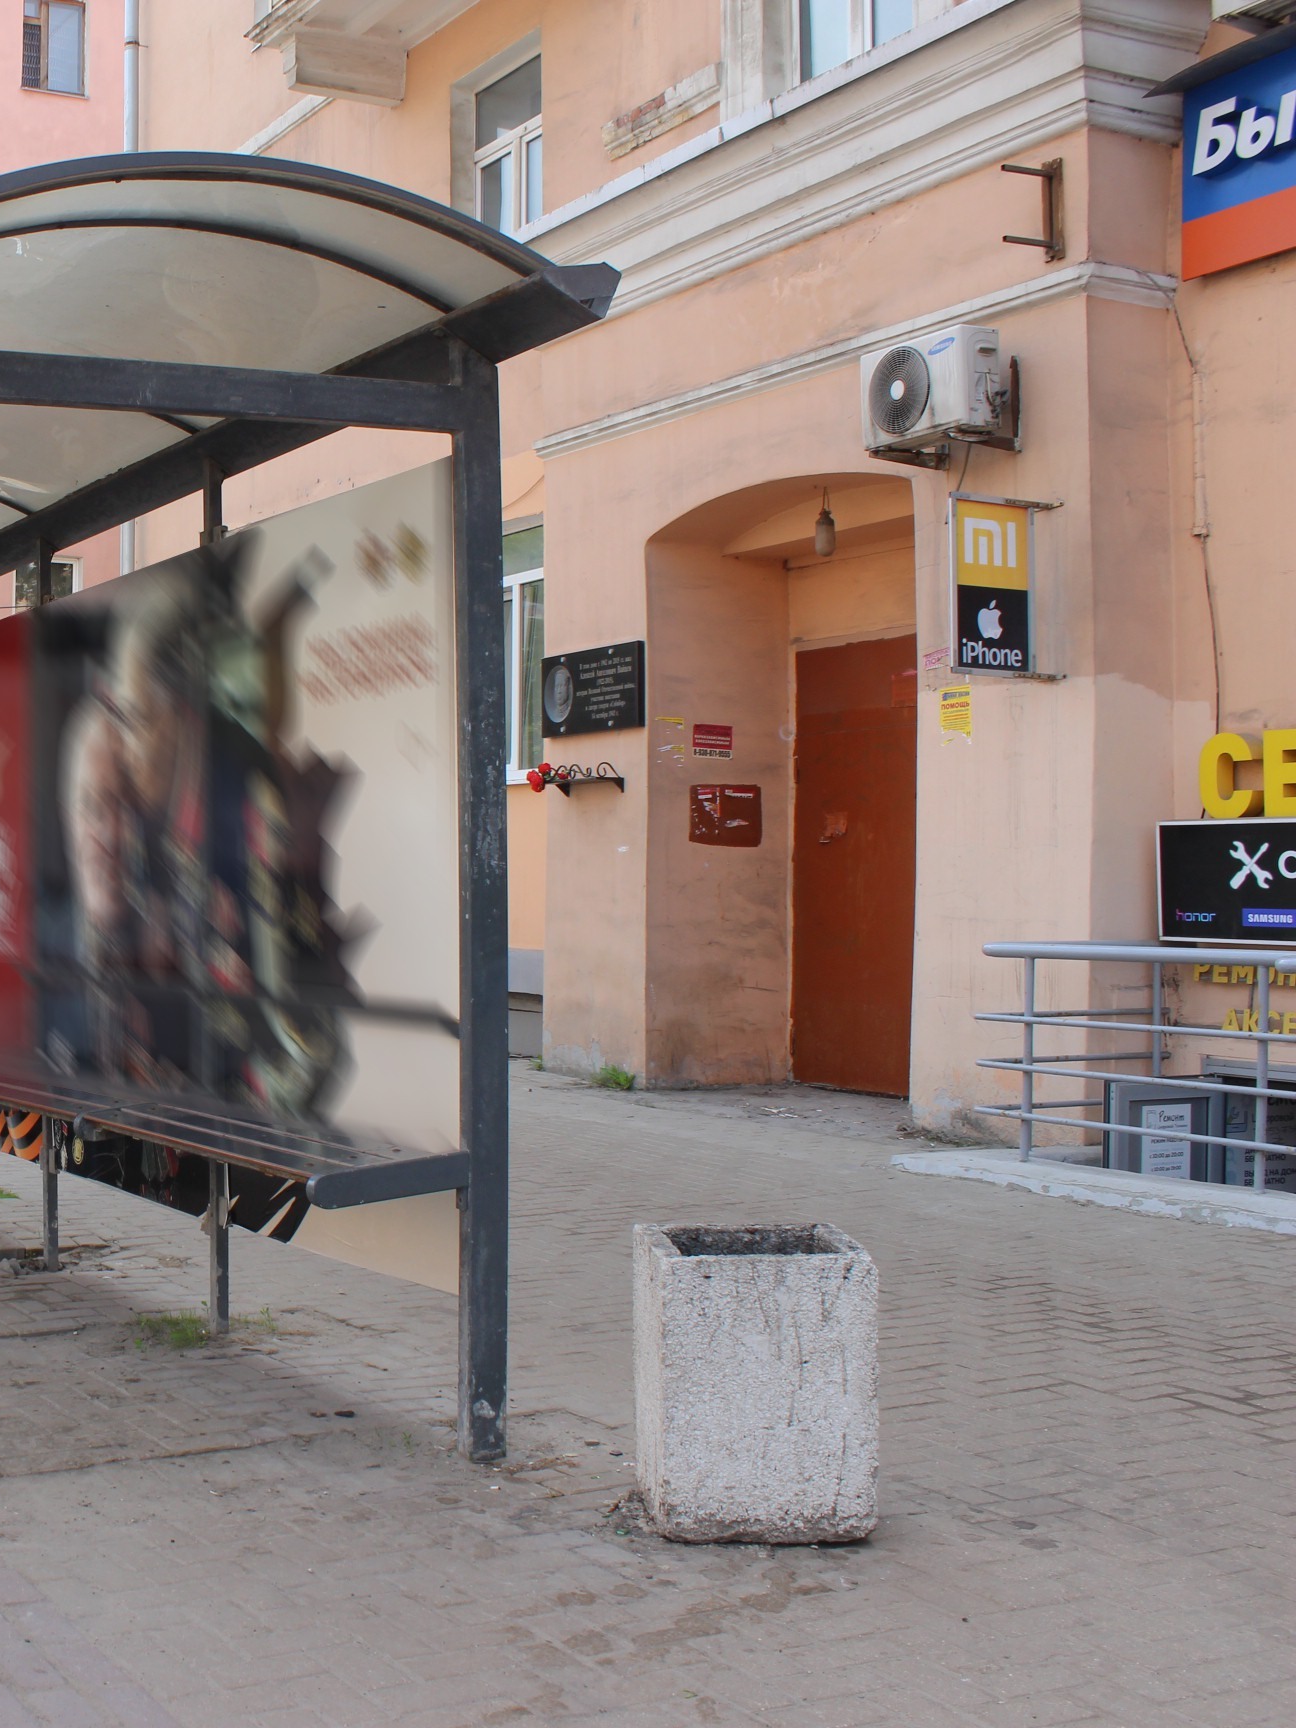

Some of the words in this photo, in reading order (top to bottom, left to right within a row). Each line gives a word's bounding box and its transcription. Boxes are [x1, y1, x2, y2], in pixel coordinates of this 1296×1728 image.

[962, 638, 1022, 667] iPhone
[941, 701, 970, 711] ПОМОЩЬ
[1176, 909, 1216, 922] honor
[1247, 913, 1294, 924] SAMSUNG
[1193, 964, 1296, 987] РЕМН
[1158, 1110, 1185, 1123] Ремонт
[1269, 1168, 1279, 1176] НА
